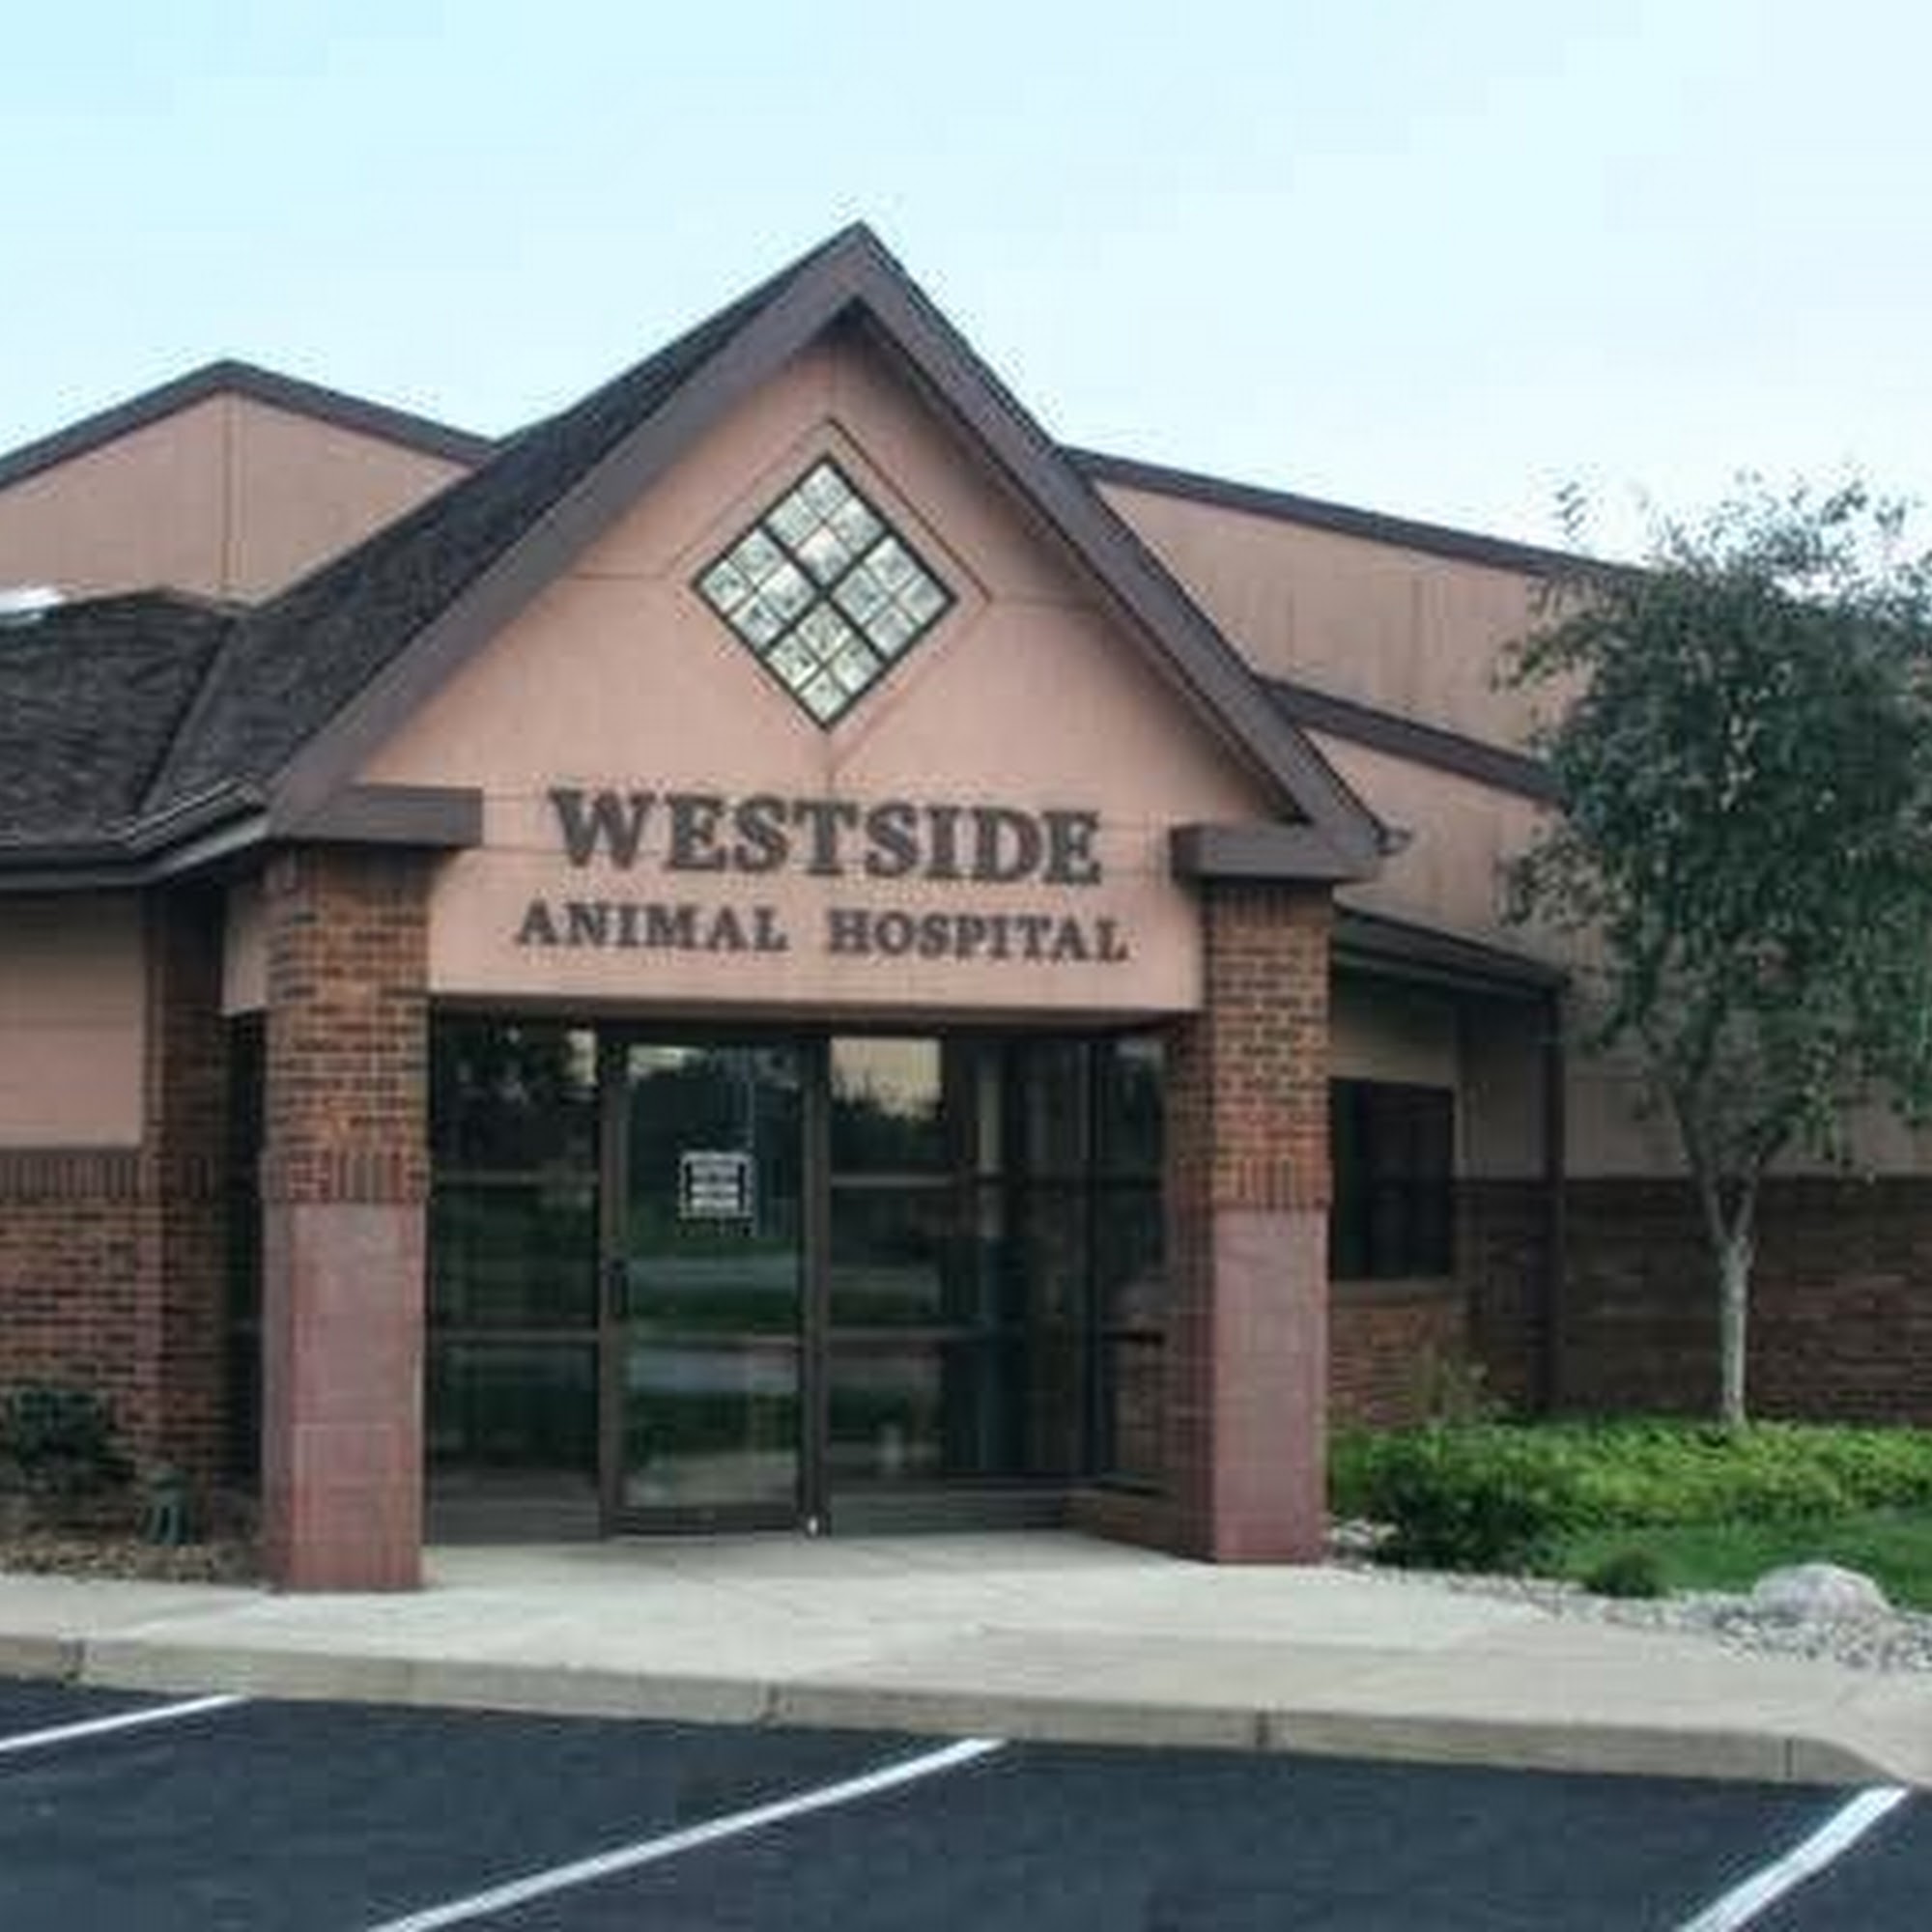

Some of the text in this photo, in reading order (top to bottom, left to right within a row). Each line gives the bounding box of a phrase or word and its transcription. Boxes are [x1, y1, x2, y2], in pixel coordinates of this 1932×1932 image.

[549, 787, 1102, 886] WESTSIDE
[516, 899, 1129, 962] ANIMAL HOSPITAL
